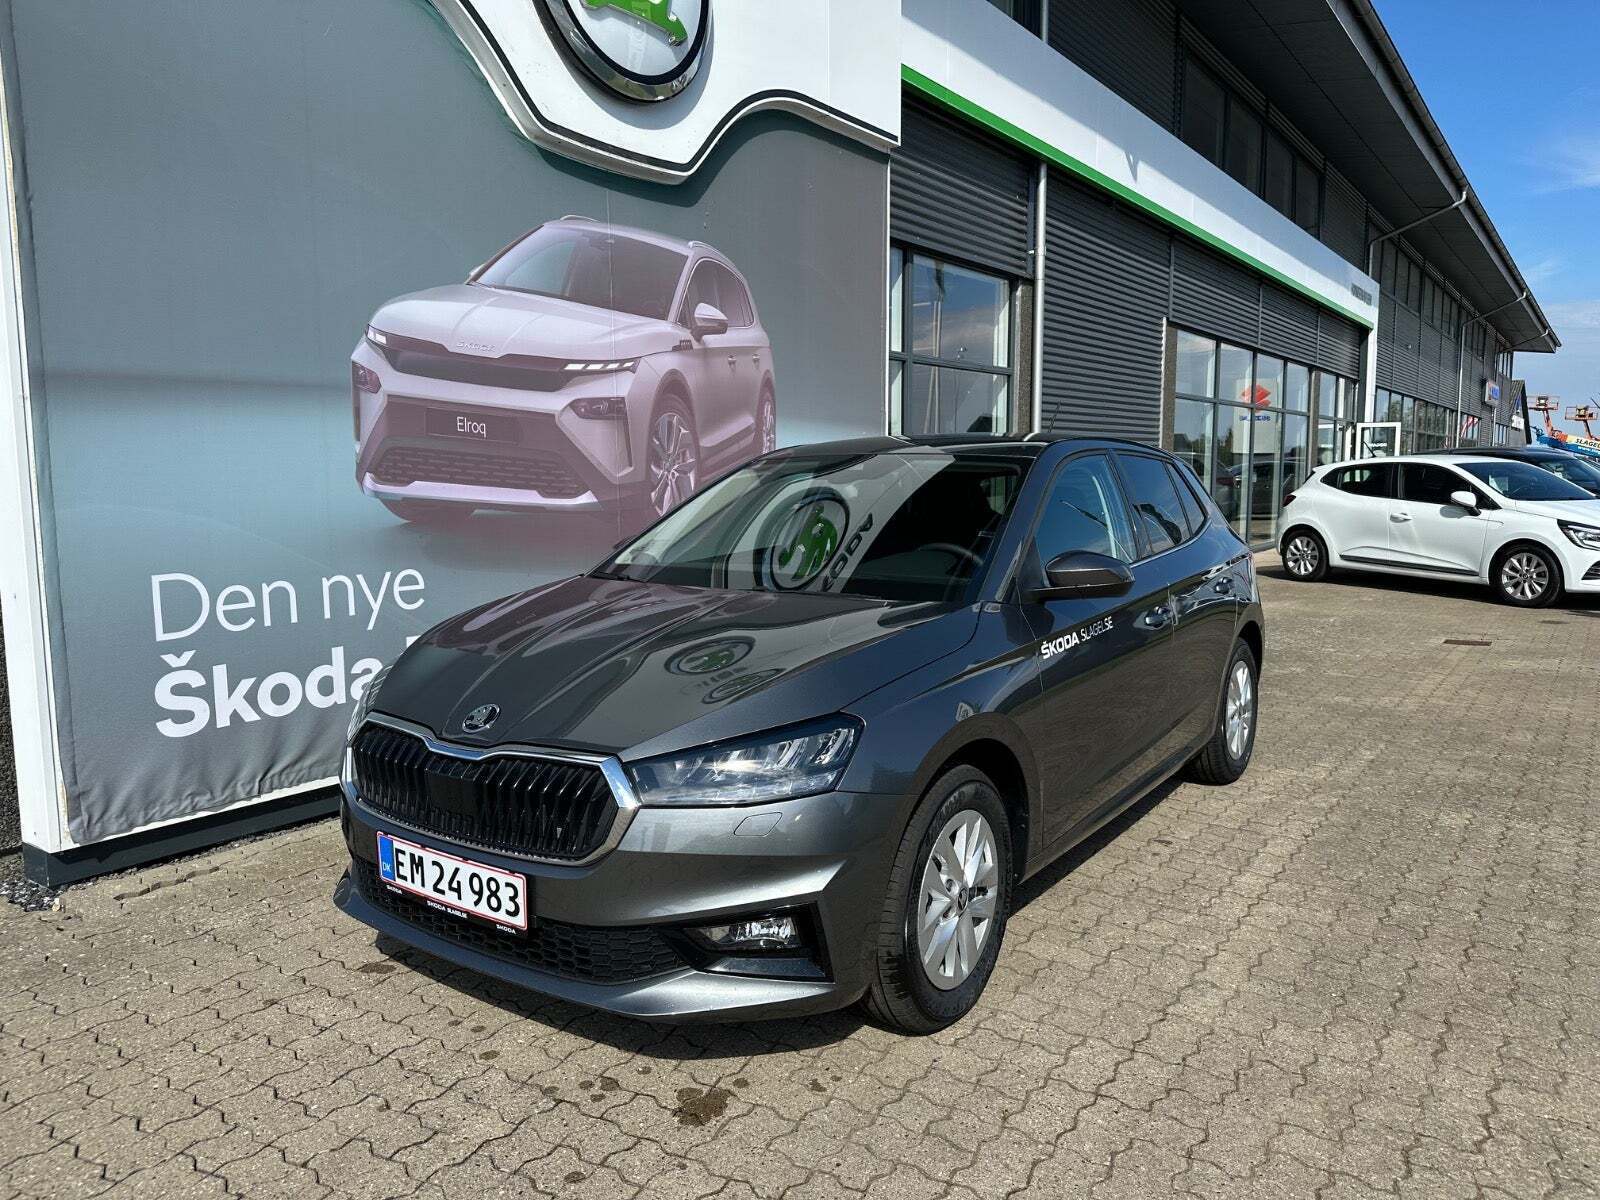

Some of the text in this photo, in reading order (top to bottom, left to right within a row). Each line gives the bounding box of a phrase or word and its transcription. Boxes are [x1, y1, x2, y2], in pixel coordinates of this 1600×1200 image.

[457, 416, 487, 438] Elroq
[151, 568, 425, 642] Den nye
[1041, 616, 1114, 660] ŠKODA SLAGELSE
[154, 645, 384, 738] Škoda
[382, 861, 391, 873] DK
[394, 847, 520, 918] EM 24 983
